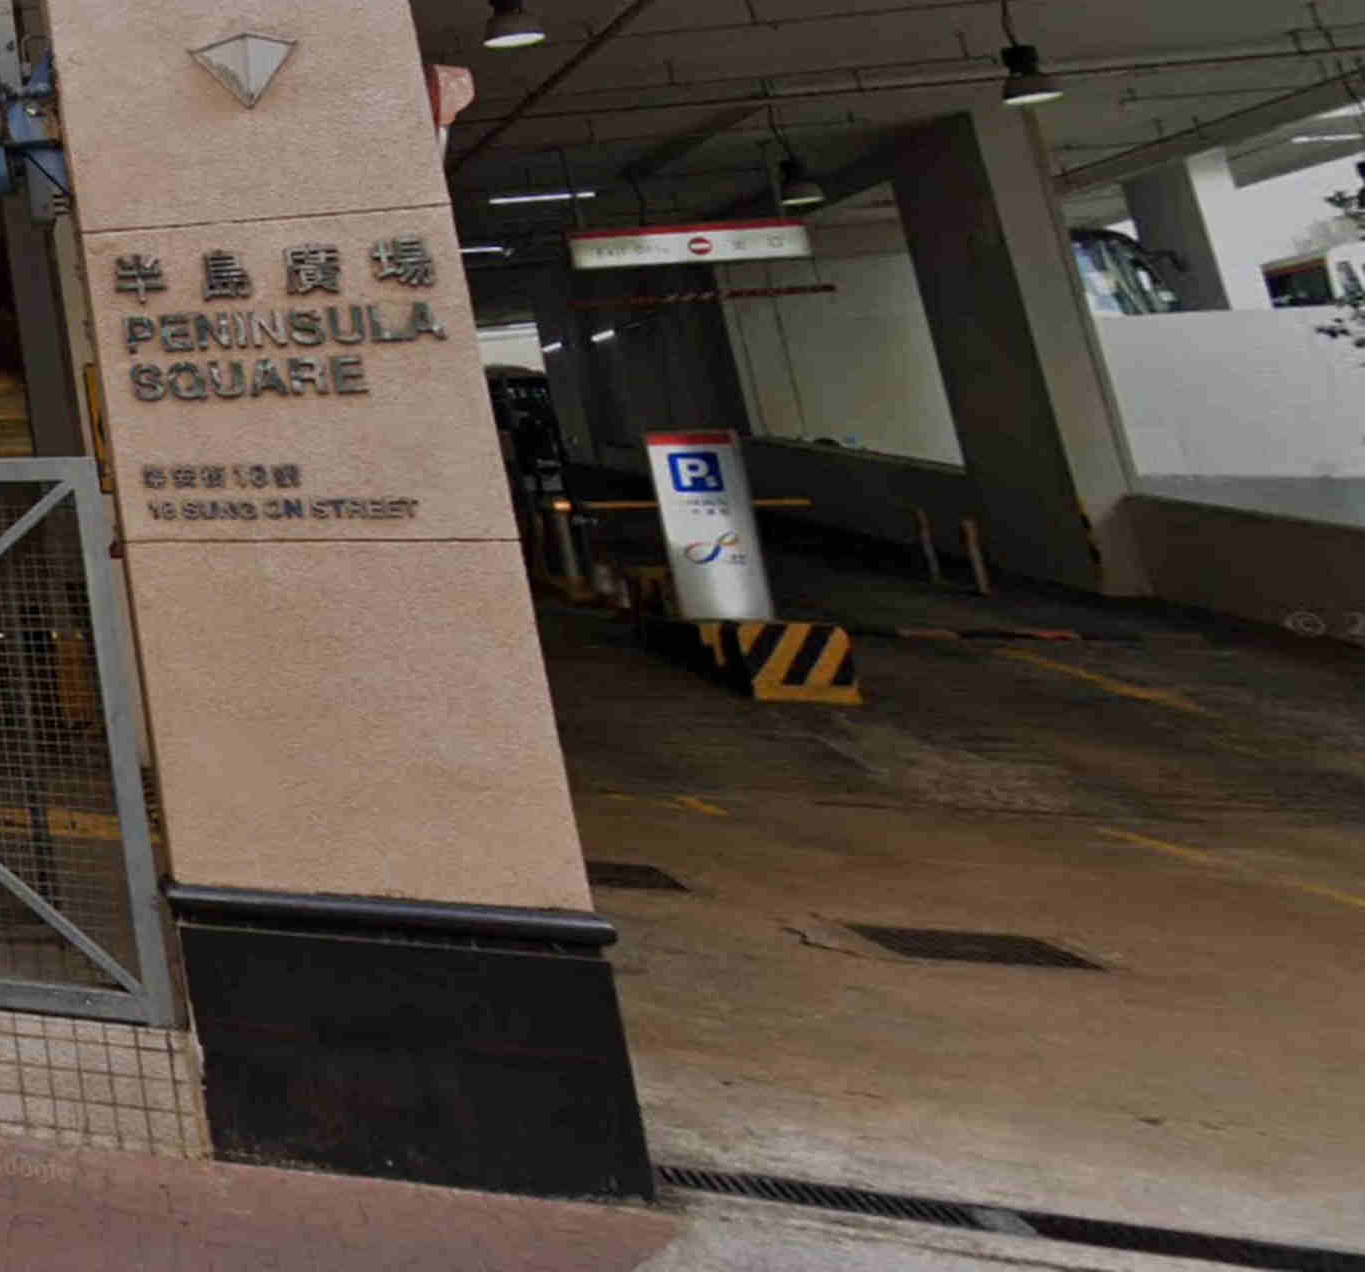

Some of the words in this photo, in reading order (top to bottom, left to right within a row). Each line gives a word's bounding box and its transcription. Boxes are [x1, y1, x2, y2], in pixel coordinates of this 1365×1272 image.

[114, 233, 436, 305] 半島廣場
[125, 301, 448, 355] PENINSULA
[129, 354, 370, 403] SQUARE
[263, 498, 304, 521] ON
[310, 496, 419, 520] STREET
